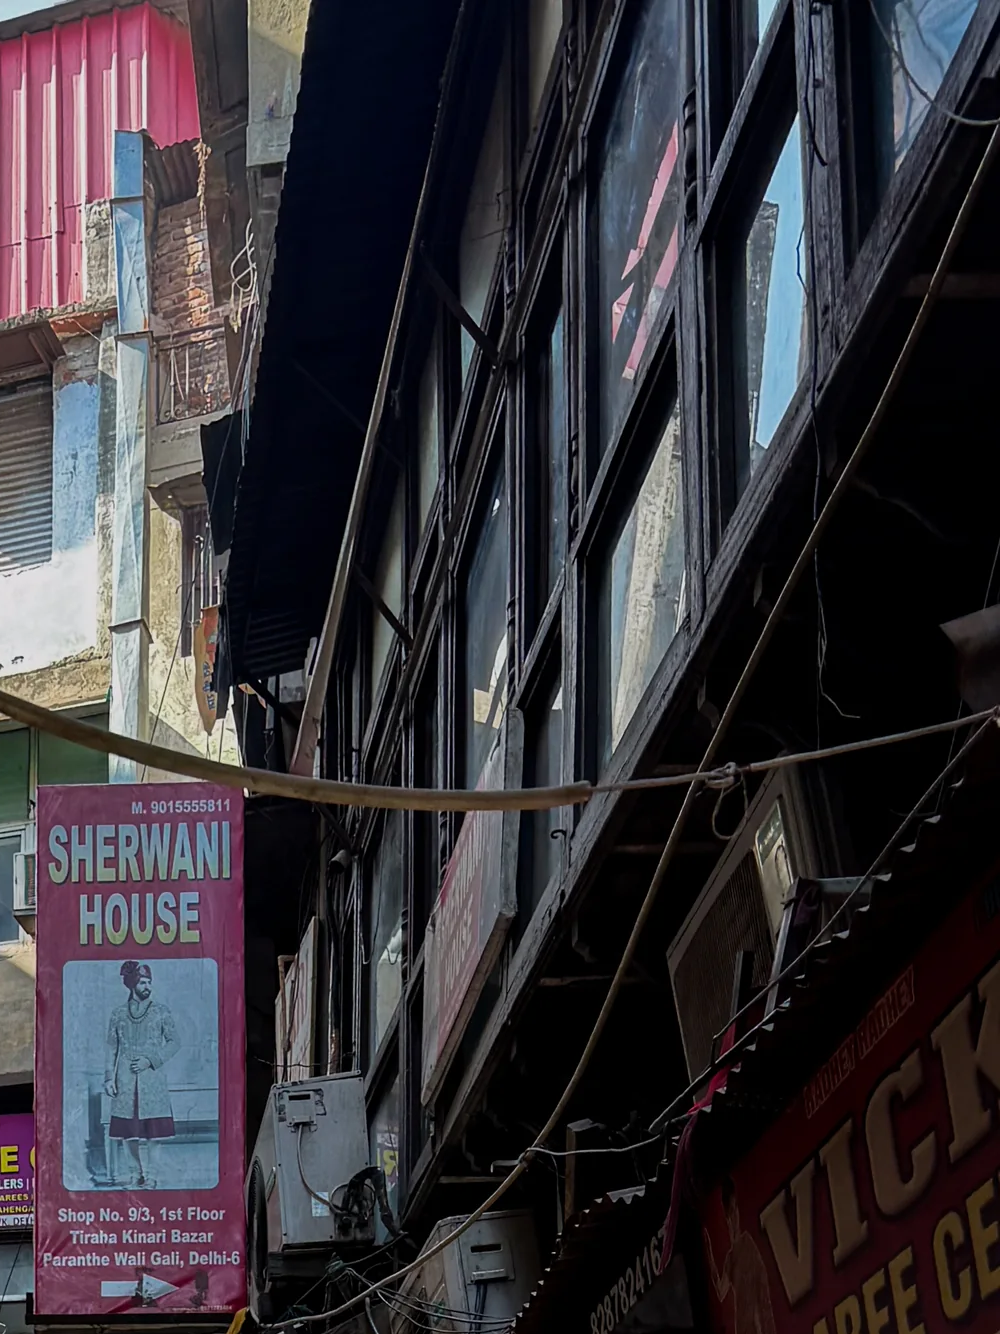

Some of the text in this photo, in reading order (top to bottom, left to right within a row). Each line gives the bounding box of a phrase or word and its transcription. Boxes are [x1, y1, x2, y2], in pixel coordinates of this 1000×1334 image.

[131, 799, 230, 814] M. 9015555811
[48, 821, 231, 884] SHERWANI
[79, 891, 201, 945] HOUSE
[58, 1206, 225, 1225] Shop No. 9/3, 1st Floor
[69, 1229, 213, 1244] Tiraha Kinari Bazar
[43, 1251, 241, 1268] Paranthe Wali Gali, Delhi-6
